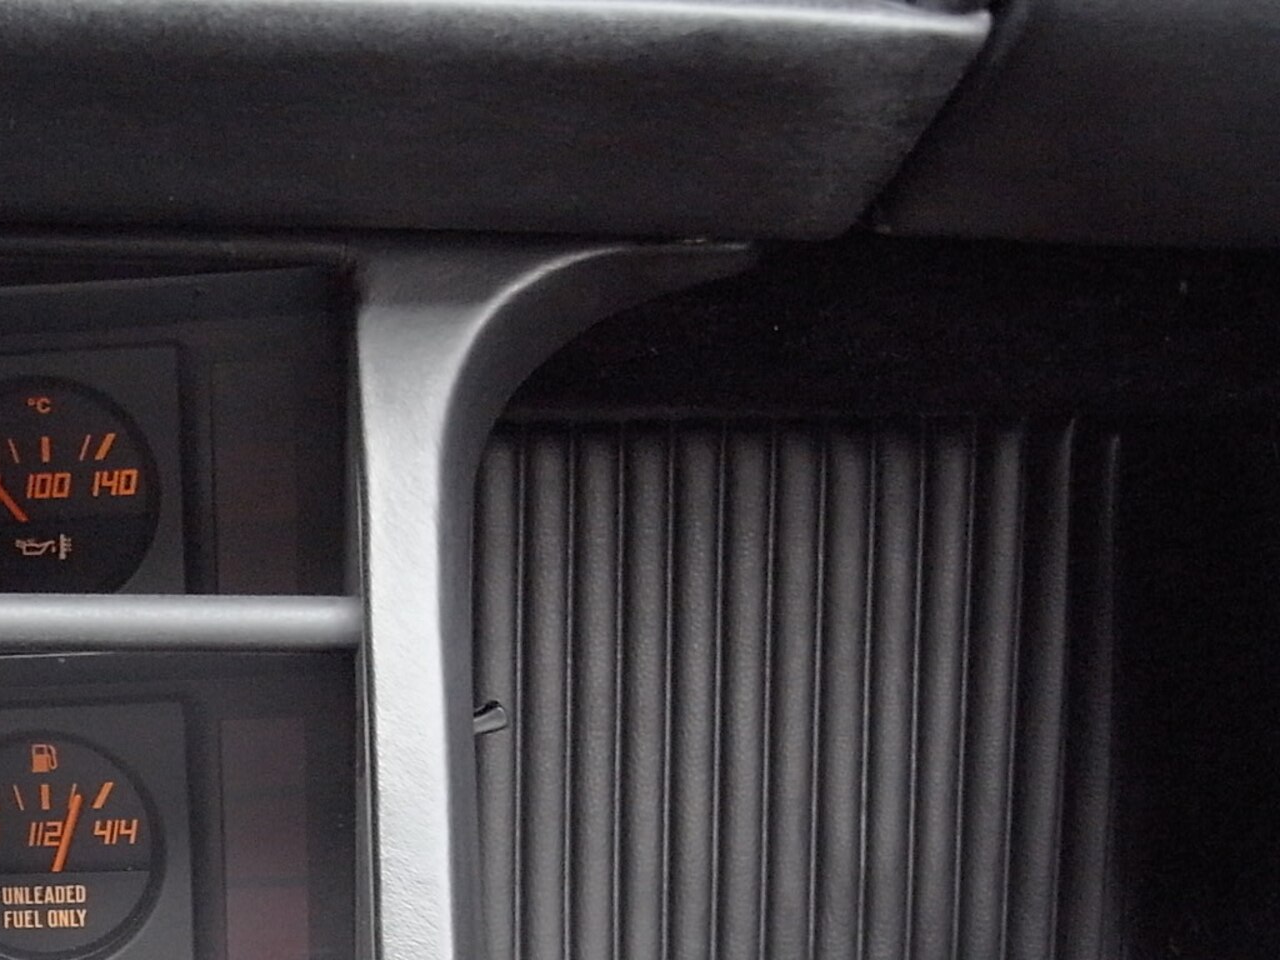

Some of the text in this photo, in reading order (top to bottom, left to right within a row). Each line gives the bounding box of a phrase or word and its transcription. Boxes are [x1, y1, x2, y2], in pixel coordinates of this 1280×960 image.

[26, 472, 71, 499] 100
[92, 468, 138, 497] 140
[2, 885, 86, 905] UNLEADED
[4, 909, 87, 929] FUEL ONLY
